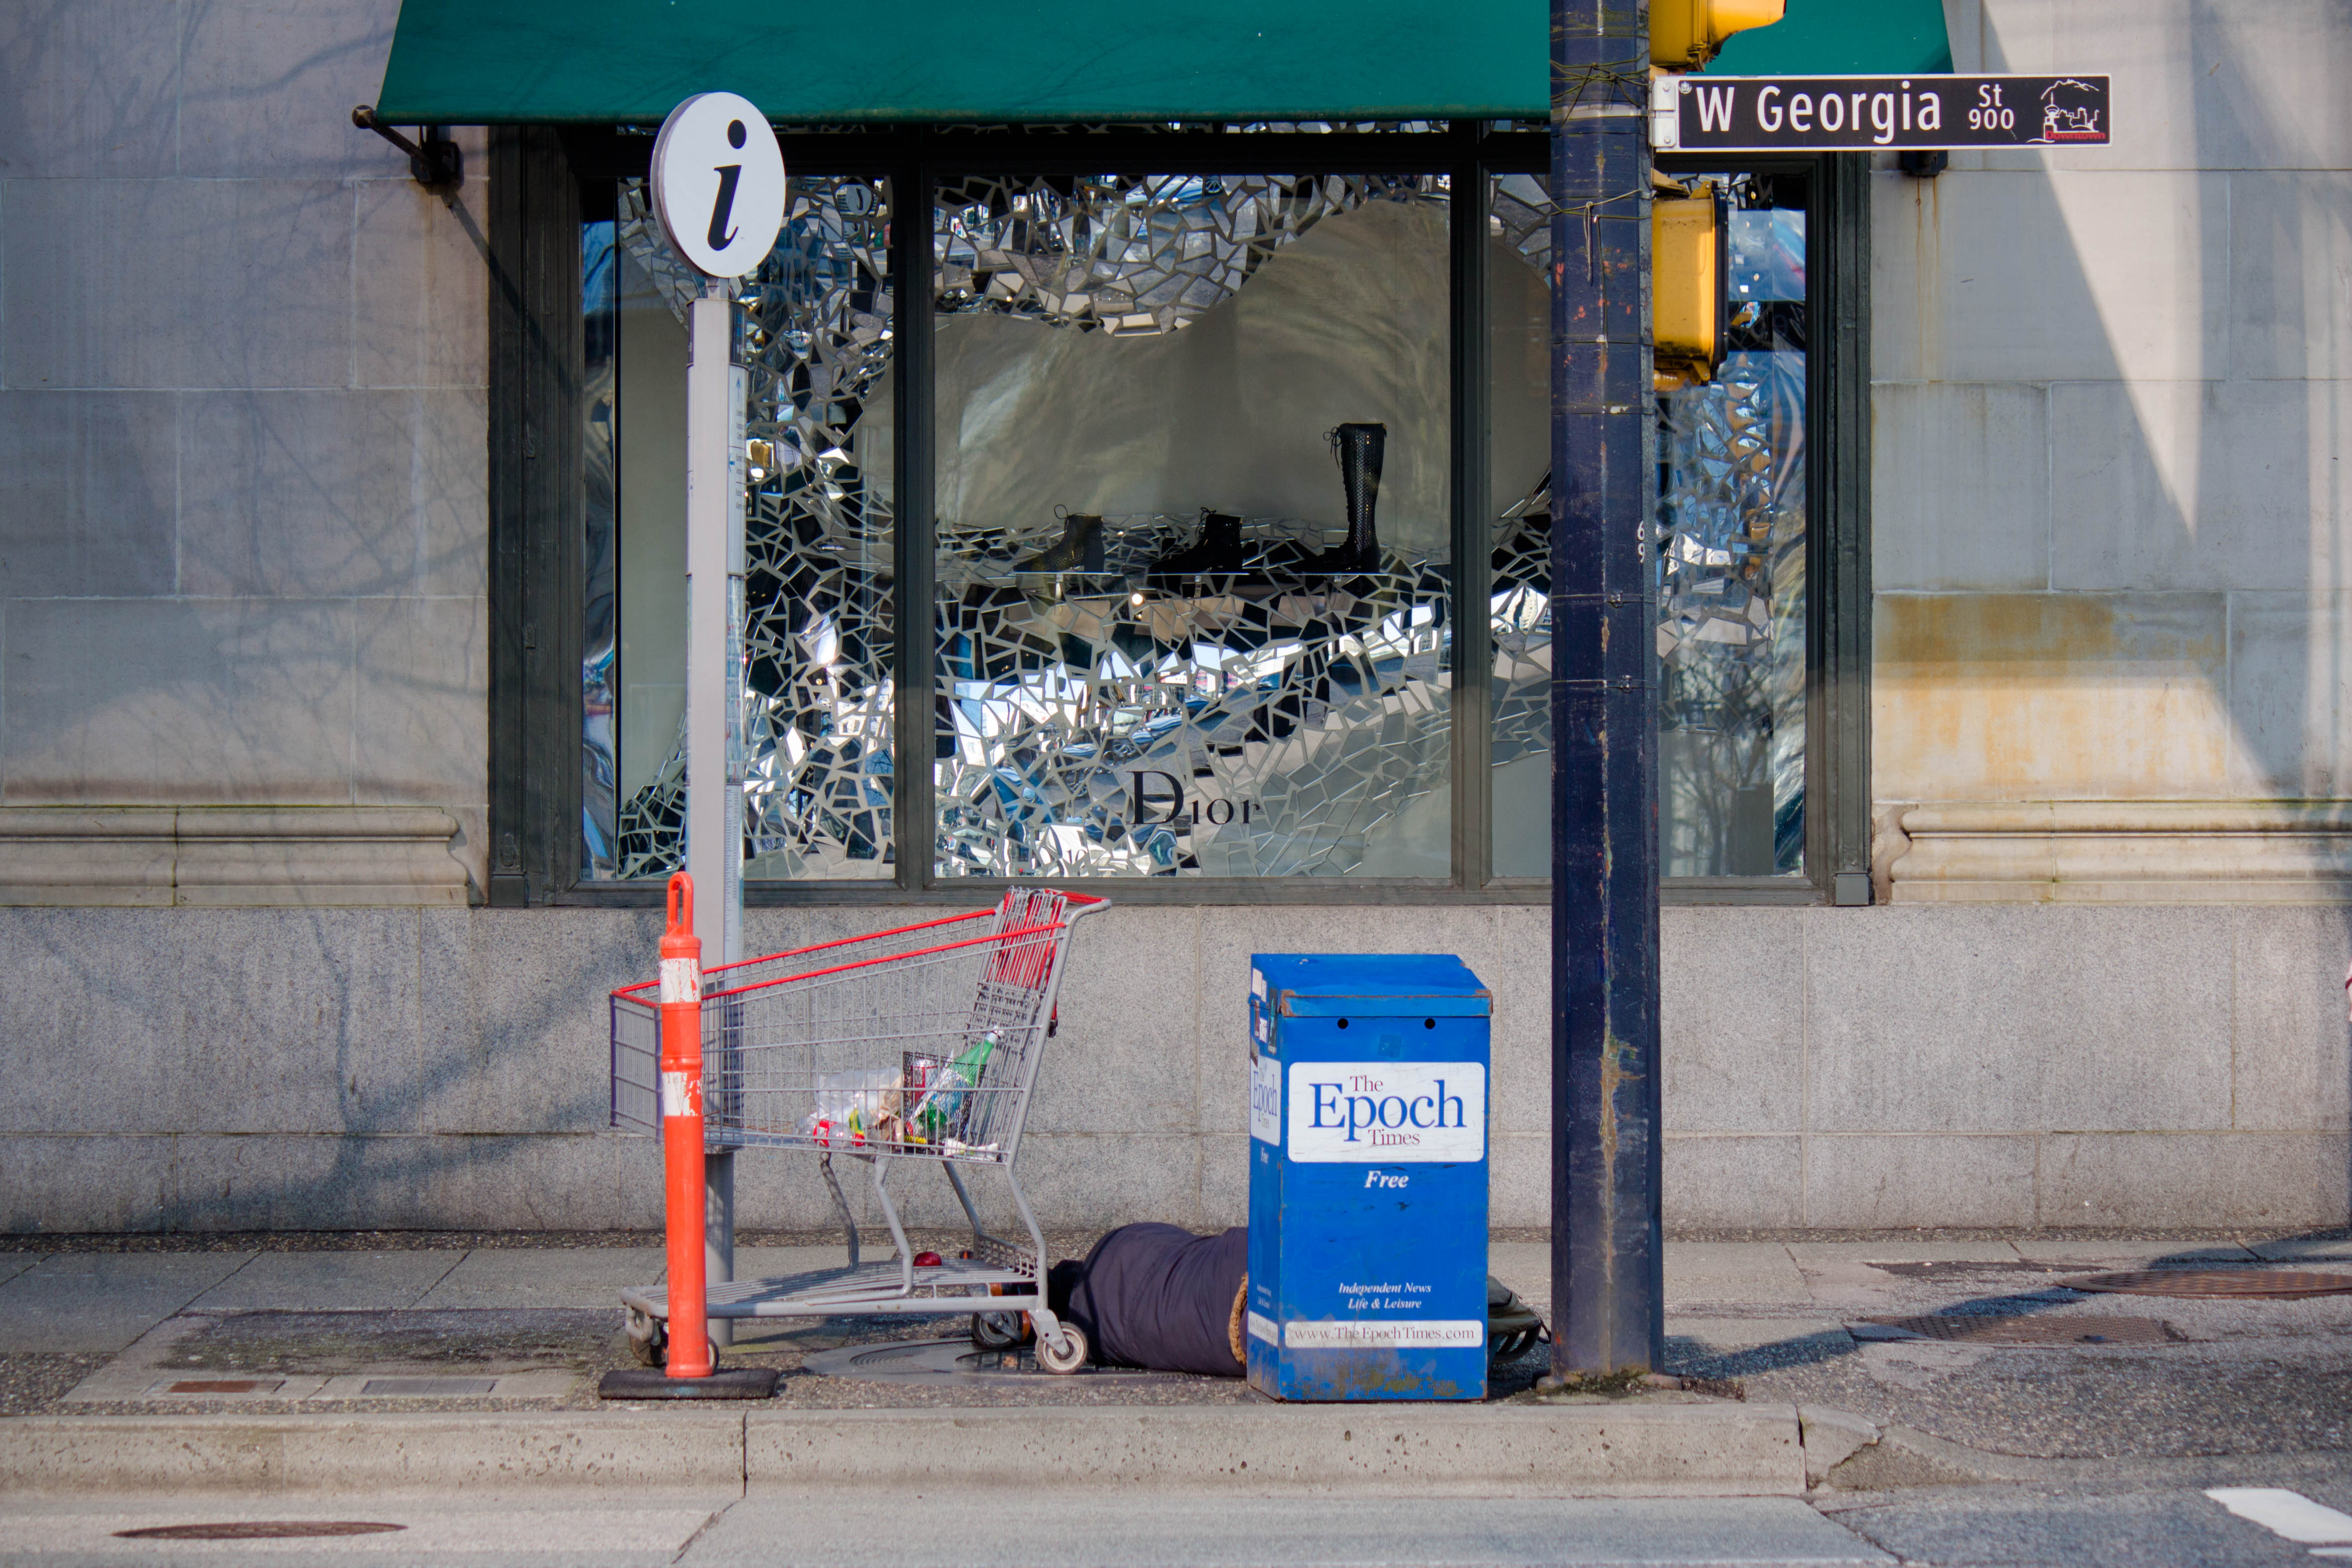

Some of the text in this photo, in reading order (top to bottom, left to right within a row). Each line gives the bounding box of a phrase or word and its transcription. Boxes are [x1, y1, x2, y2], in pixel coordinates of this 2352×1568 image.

[1978, 84, 2002, 108] St
[1696, 82, 1942, 144] W Georgia
[1968, 108, 2015, 130] 900
[2045, 130, 2106, 140] Downtown
[707, 119, 747, 251] i
[1125, 770, 1261, 825] Dior
[1349, 1075, 1384, 1092] The
[1253, 1070, 1277, 1122] Epoch
[1308, 1079, 1467, 1142] Epoch
[1368, 1128, 1421, 1146] Times
[1364, 1170, 1410, 1189] Free
[1338, 1282, 1432, 1296] Independent News
[1348, 1298, 1422, 1311] Life & Leisure
